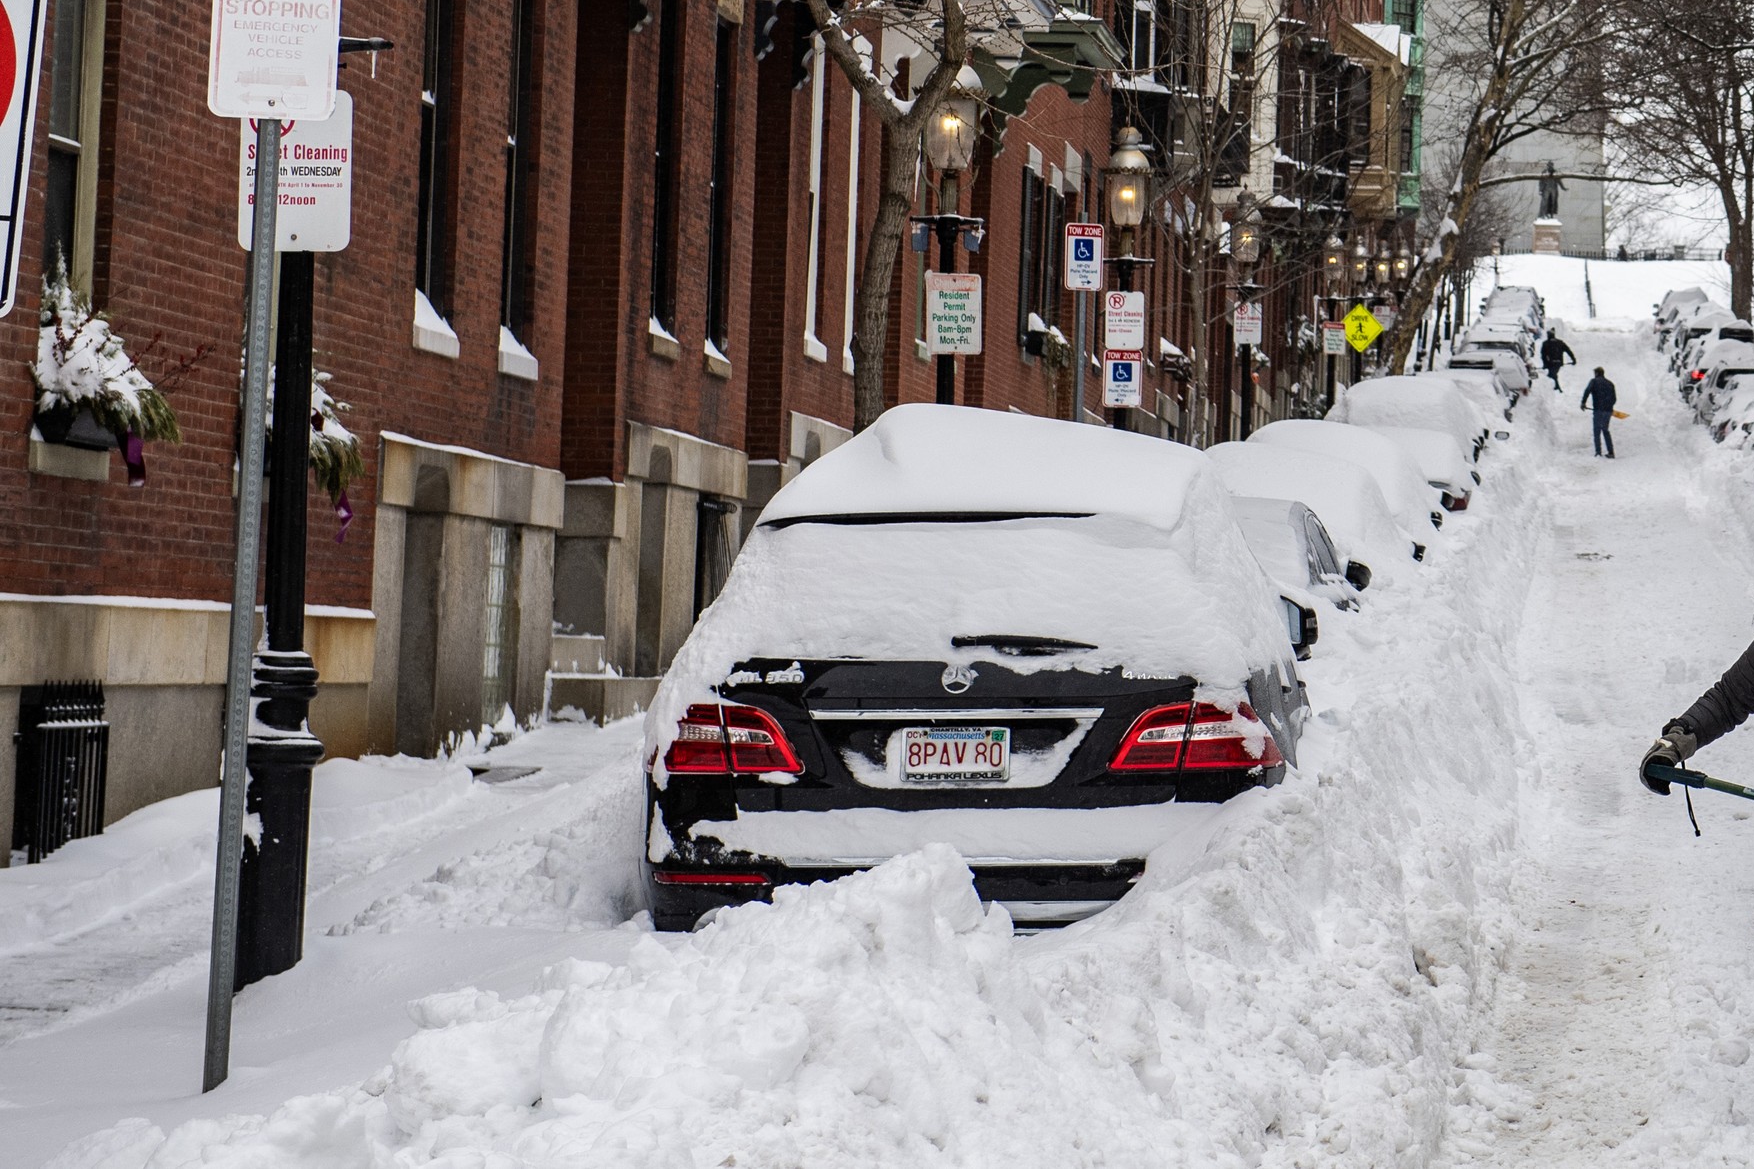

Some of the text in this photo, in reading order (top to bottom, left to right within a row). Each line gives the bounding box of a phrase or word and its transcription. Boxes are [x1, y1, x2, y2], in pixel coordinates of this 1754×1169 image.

[234, 20, 317, 34] EMERGENCY
[248, 33, 304, 45] VEHICLE
[247, 47, 302, 60] ACCESS
[294, 144, 348, 163] Cleaning
[246, 167, 256, 177] 2n
[290, 166, 342, 177] WEDNESDAY
[1069, 226, 1102, 236] TOW ZONE
[939, 290, 970, 300] Resident
[943, 301, 966, 311] Permit
[932, 313, 976, 324] Parking Only
[937, 324, 972, 335] 8am-8pm
[939, 335, 970, 345] Mon.-Fri.
[1107, 351, 1140, 360] TOW ZONE
